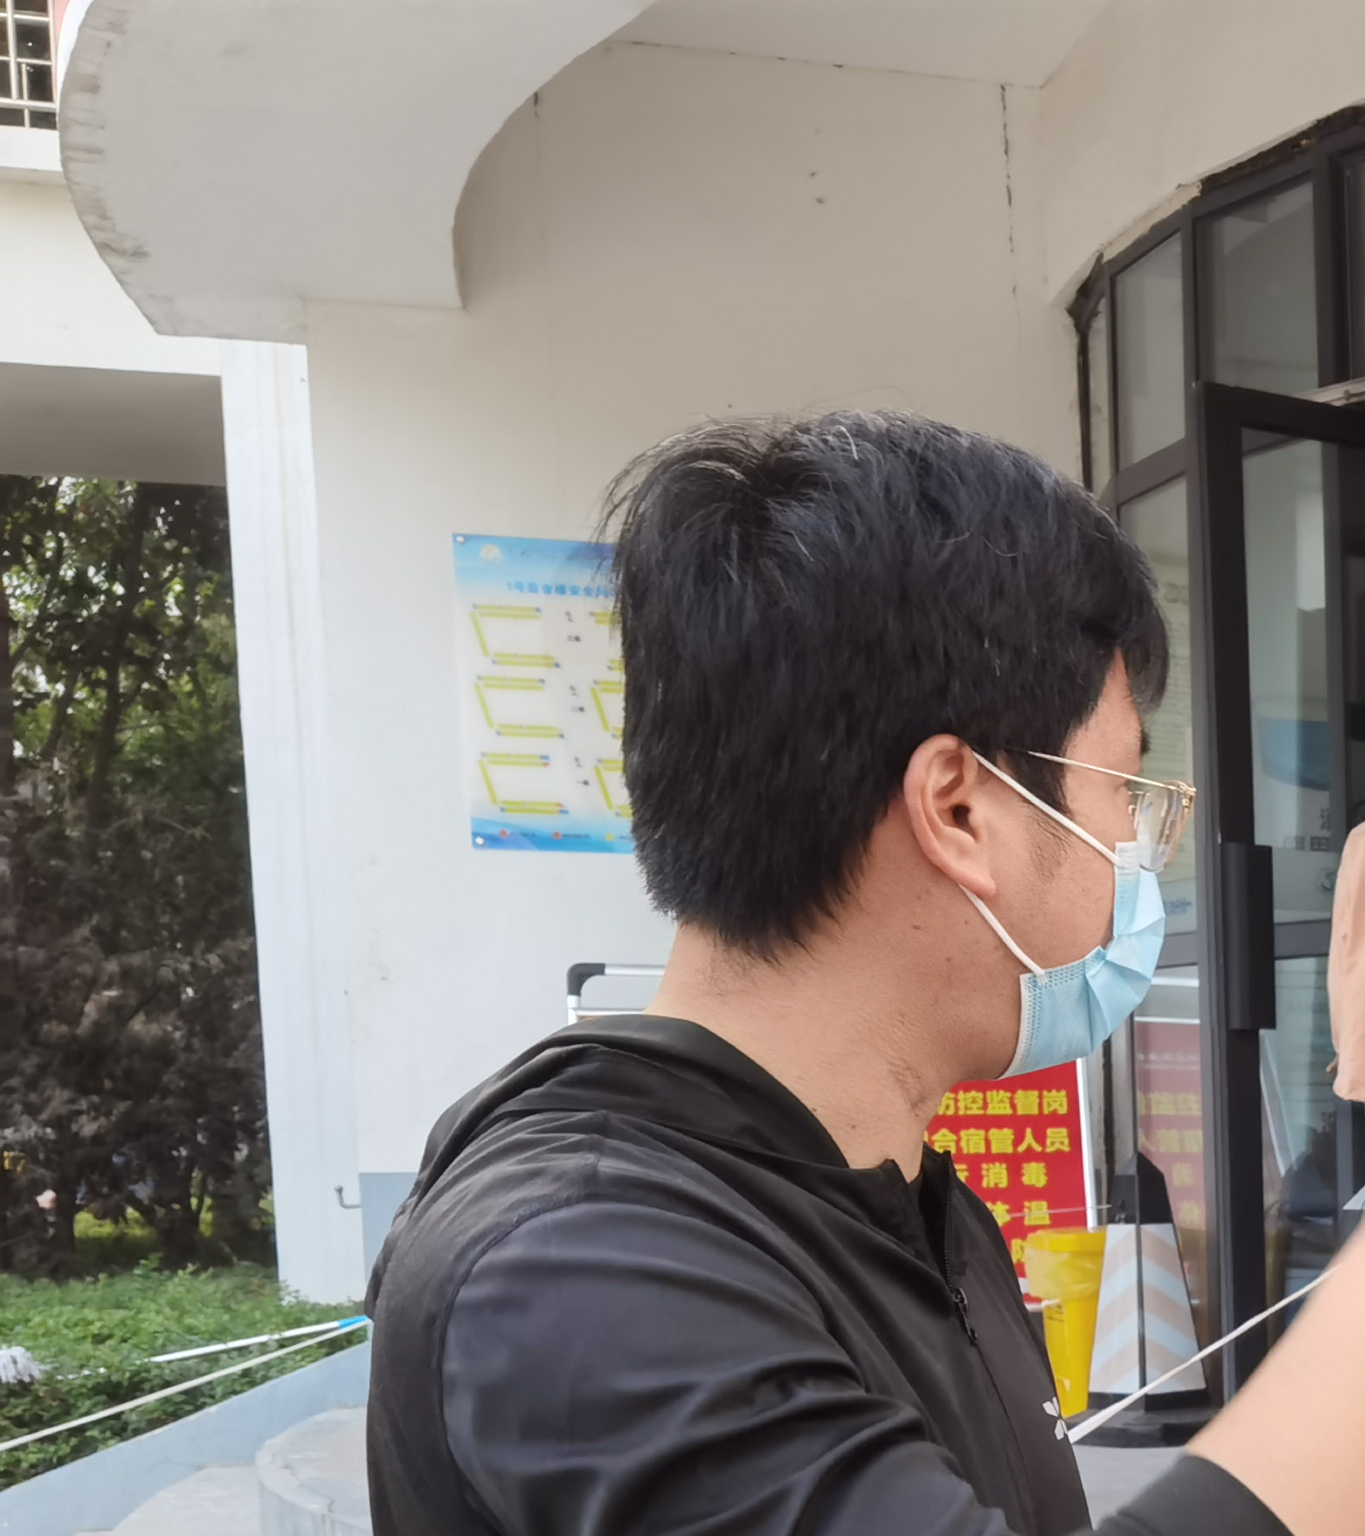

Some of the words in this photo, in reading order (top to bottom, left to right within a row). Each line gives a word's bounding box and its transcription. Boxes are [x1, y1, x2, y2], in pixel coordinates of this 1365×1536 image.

[923, 1127, 1071, 1154] 合宿管人员
